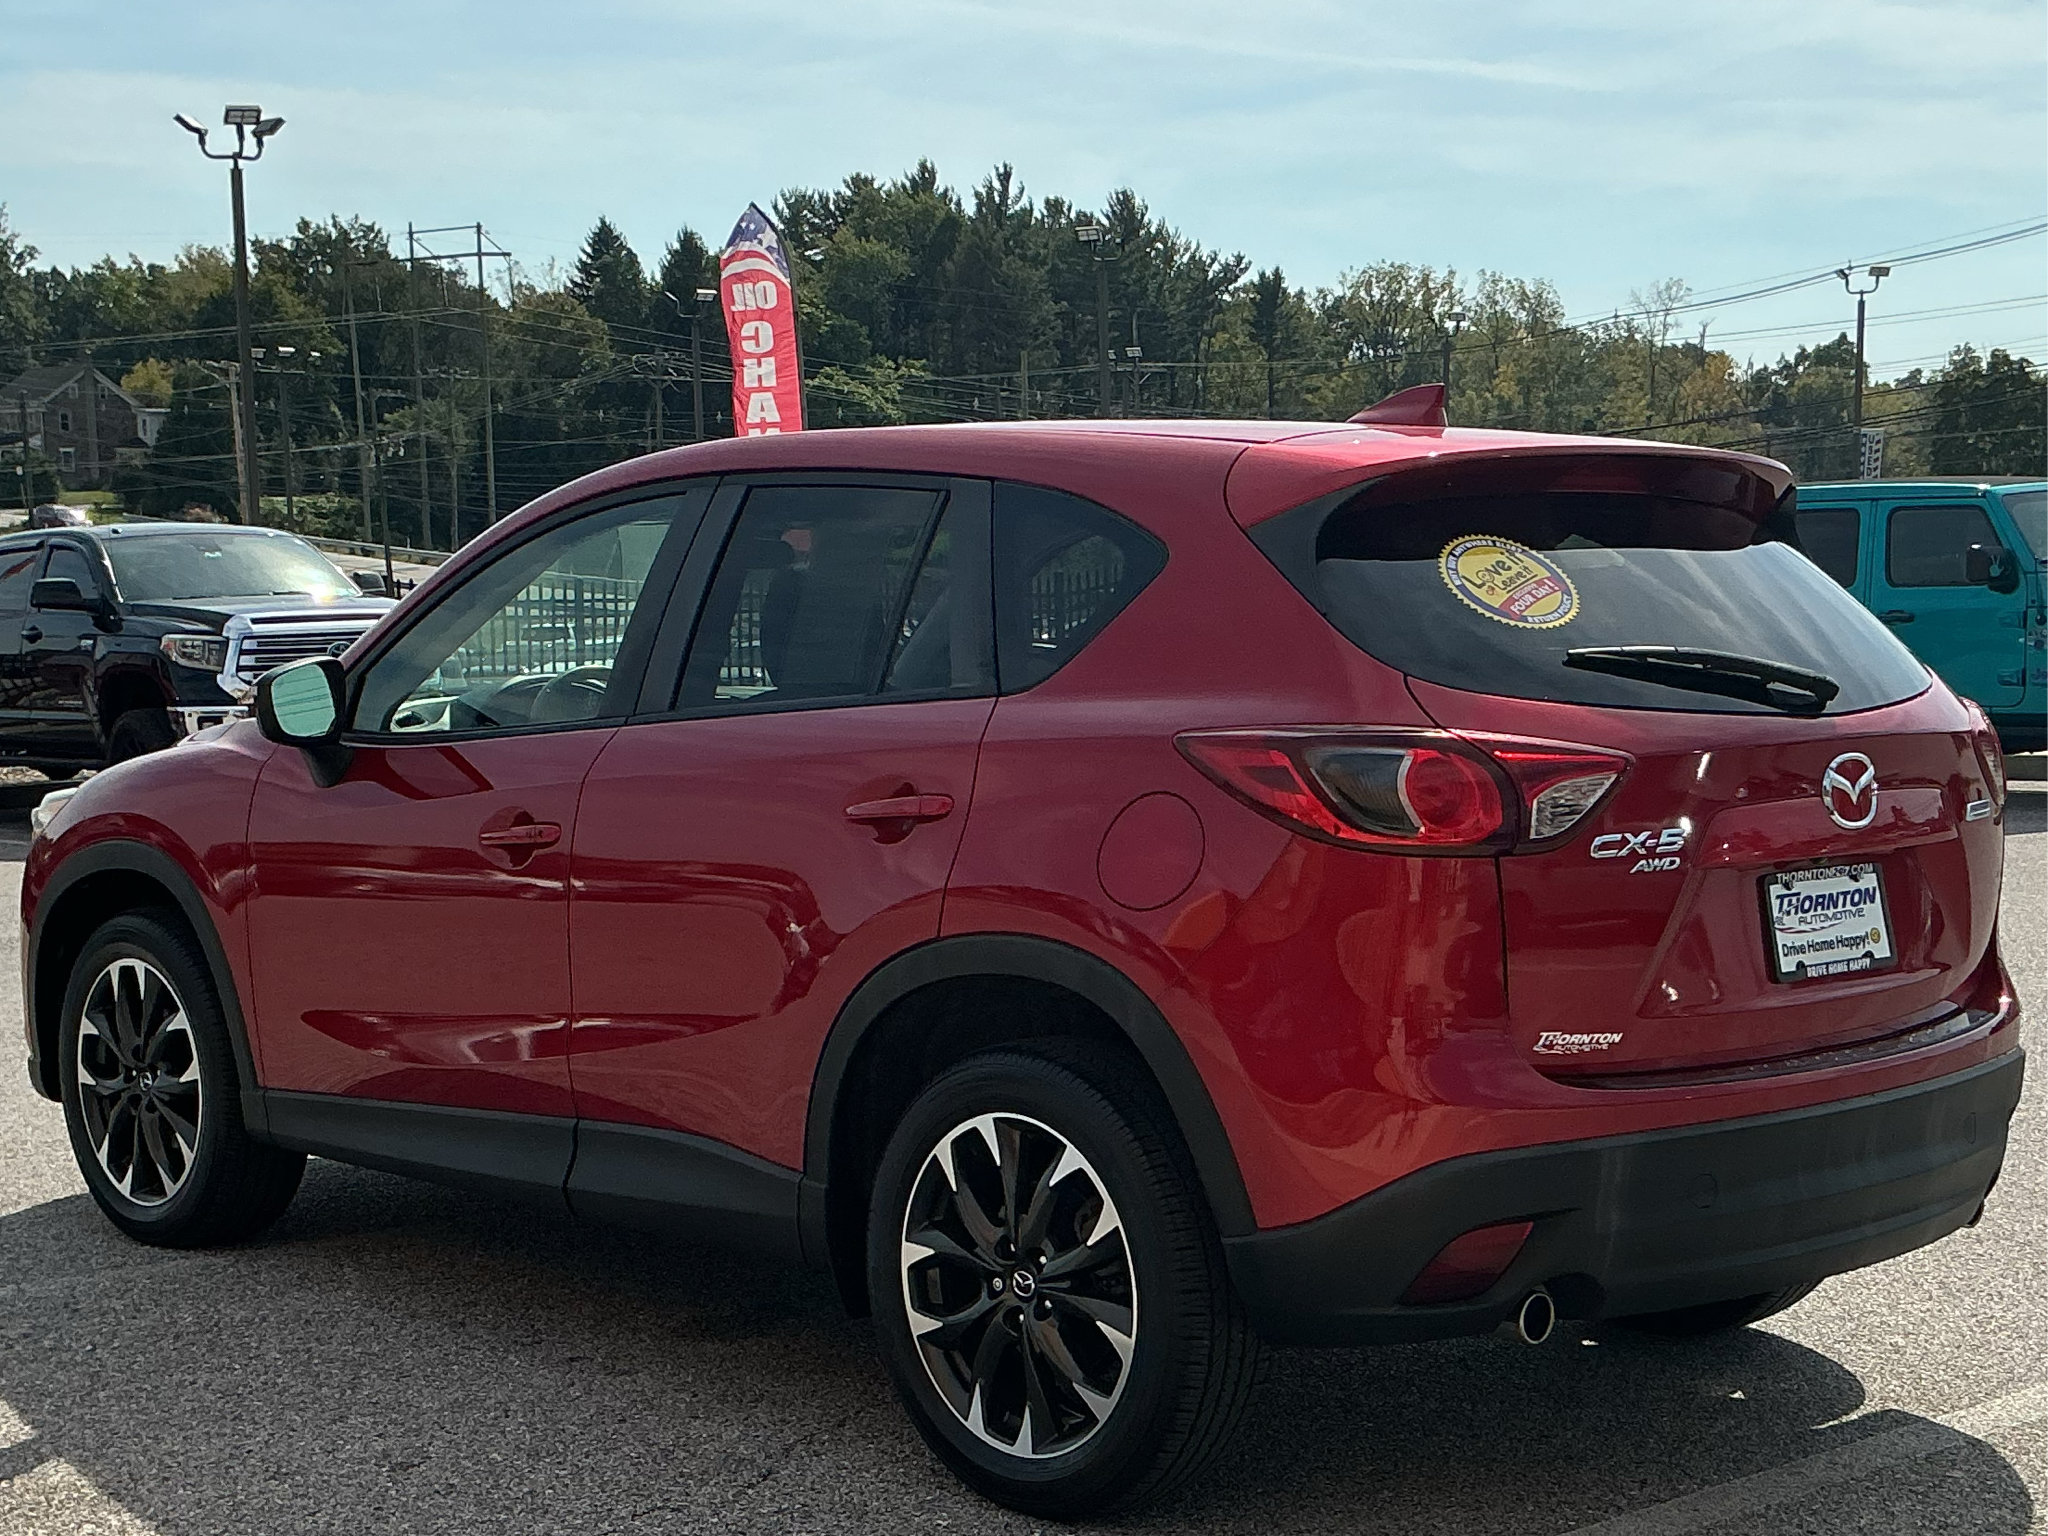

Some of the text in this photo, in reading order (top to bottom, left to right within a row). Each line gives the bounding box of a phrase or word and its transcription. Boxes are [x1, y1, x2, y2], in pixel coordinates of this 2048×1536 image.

[1461, 560, 1512, 588] Love
[1509, 594, 1537, 615] FOUR
[1590, 828, 1686, 859] CX-5
[1629, 856, 1681, 874] AWD
[1775, 886, 1877, 917] THORNTON
[1798, 907, 1865, 927] AUTOMOTIVE
[1782, 940, 1806, 958] Drive
[1807, 937, 1835, 953] Home
[1806, 963, 1828, 978] DRIVE
[1849, 957, 1871, 972] HAPPY
[1538, 1031, 1624, 1046] THORNTON
[1553, 1043, 1610, 1053] AUTOMOTIVE
